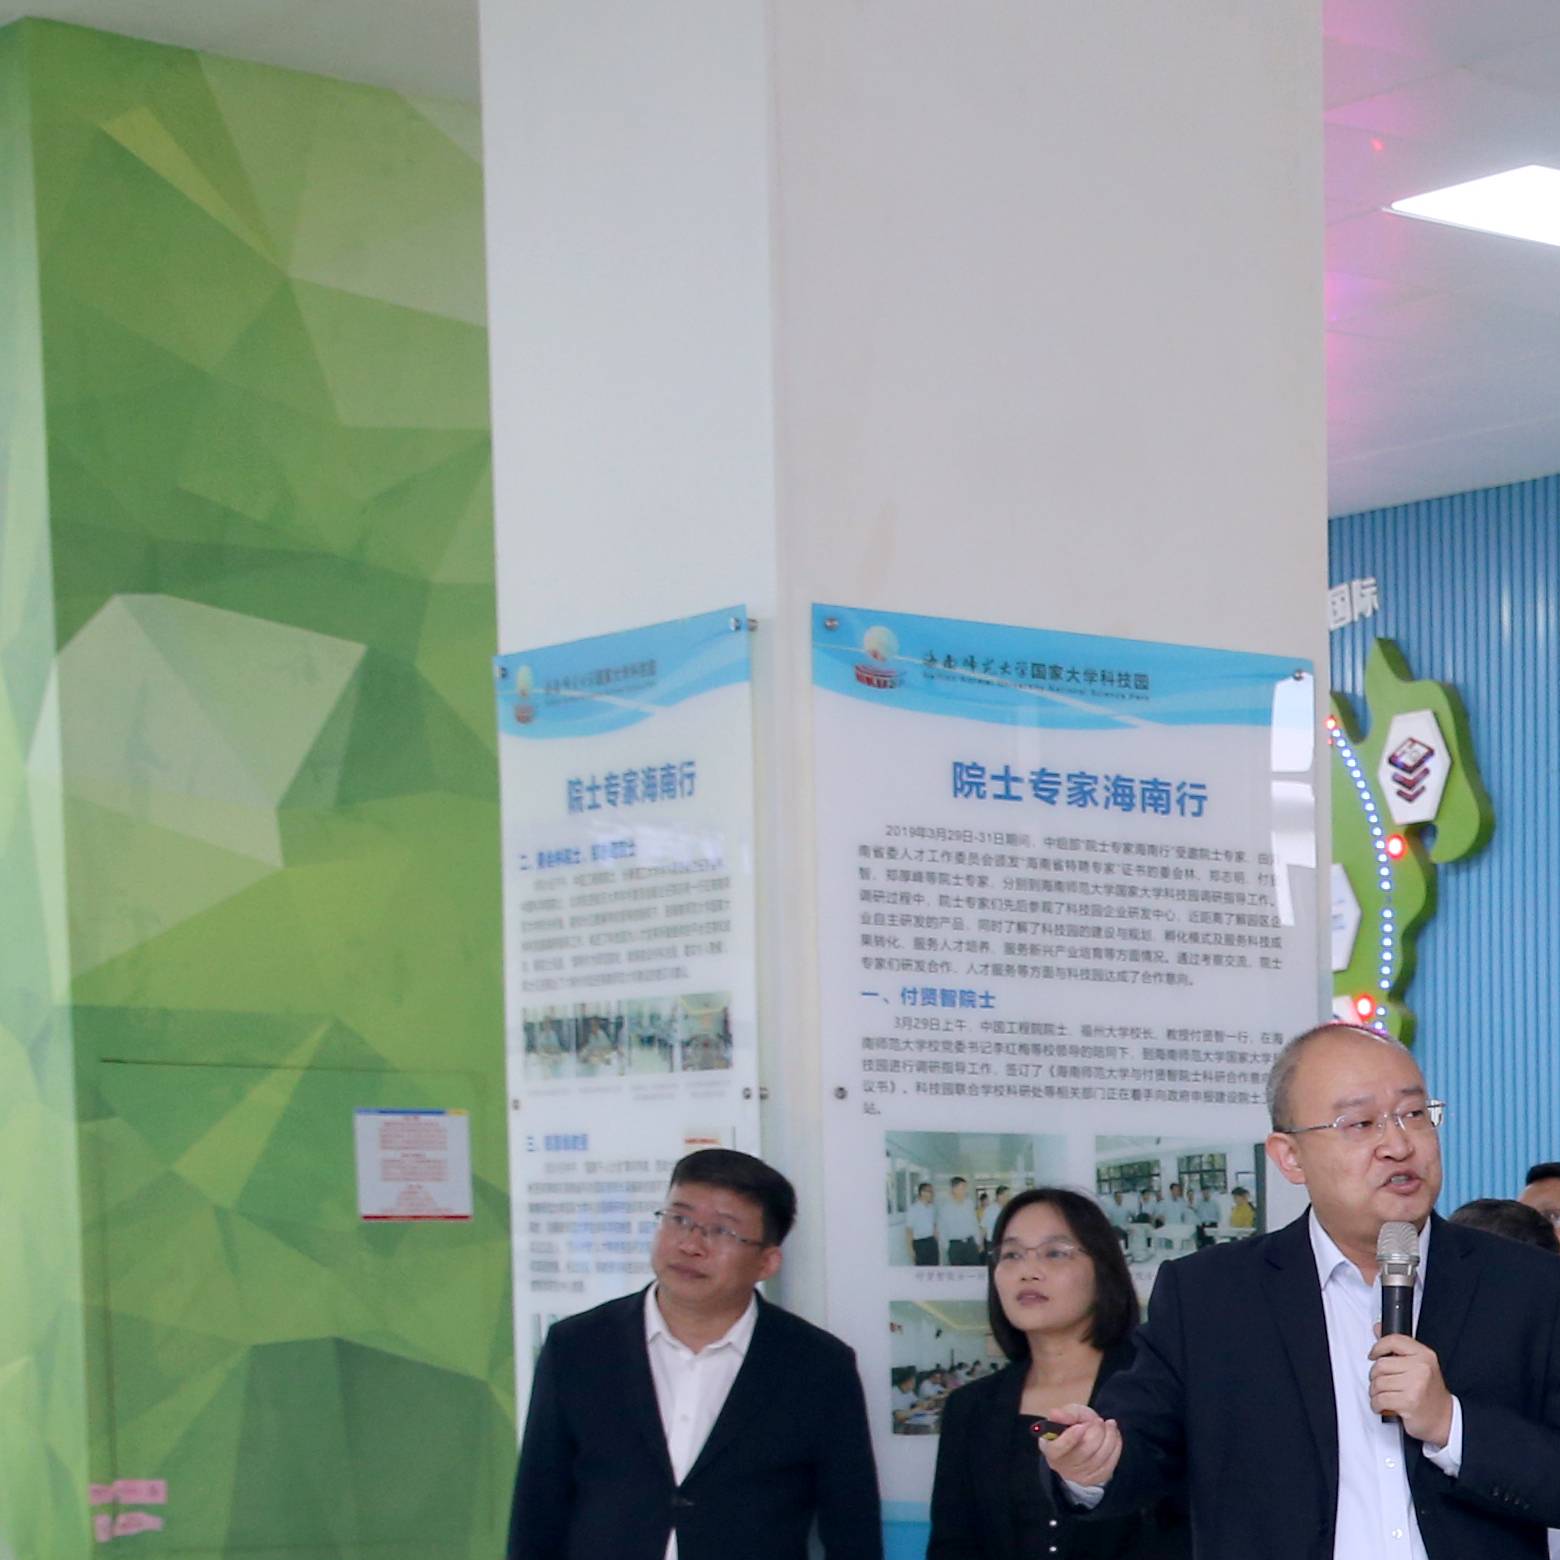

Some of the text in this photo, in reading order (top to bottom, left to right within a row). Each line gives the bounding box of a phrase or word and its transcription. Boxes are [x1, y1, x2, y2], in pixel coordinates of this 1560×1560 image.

[566, 760, 697, 815] 院士专家海南行
[951, 761, 1208, 818] 院士专家海南行
[861, 986, 996, 1009] 一、付贤智院士
